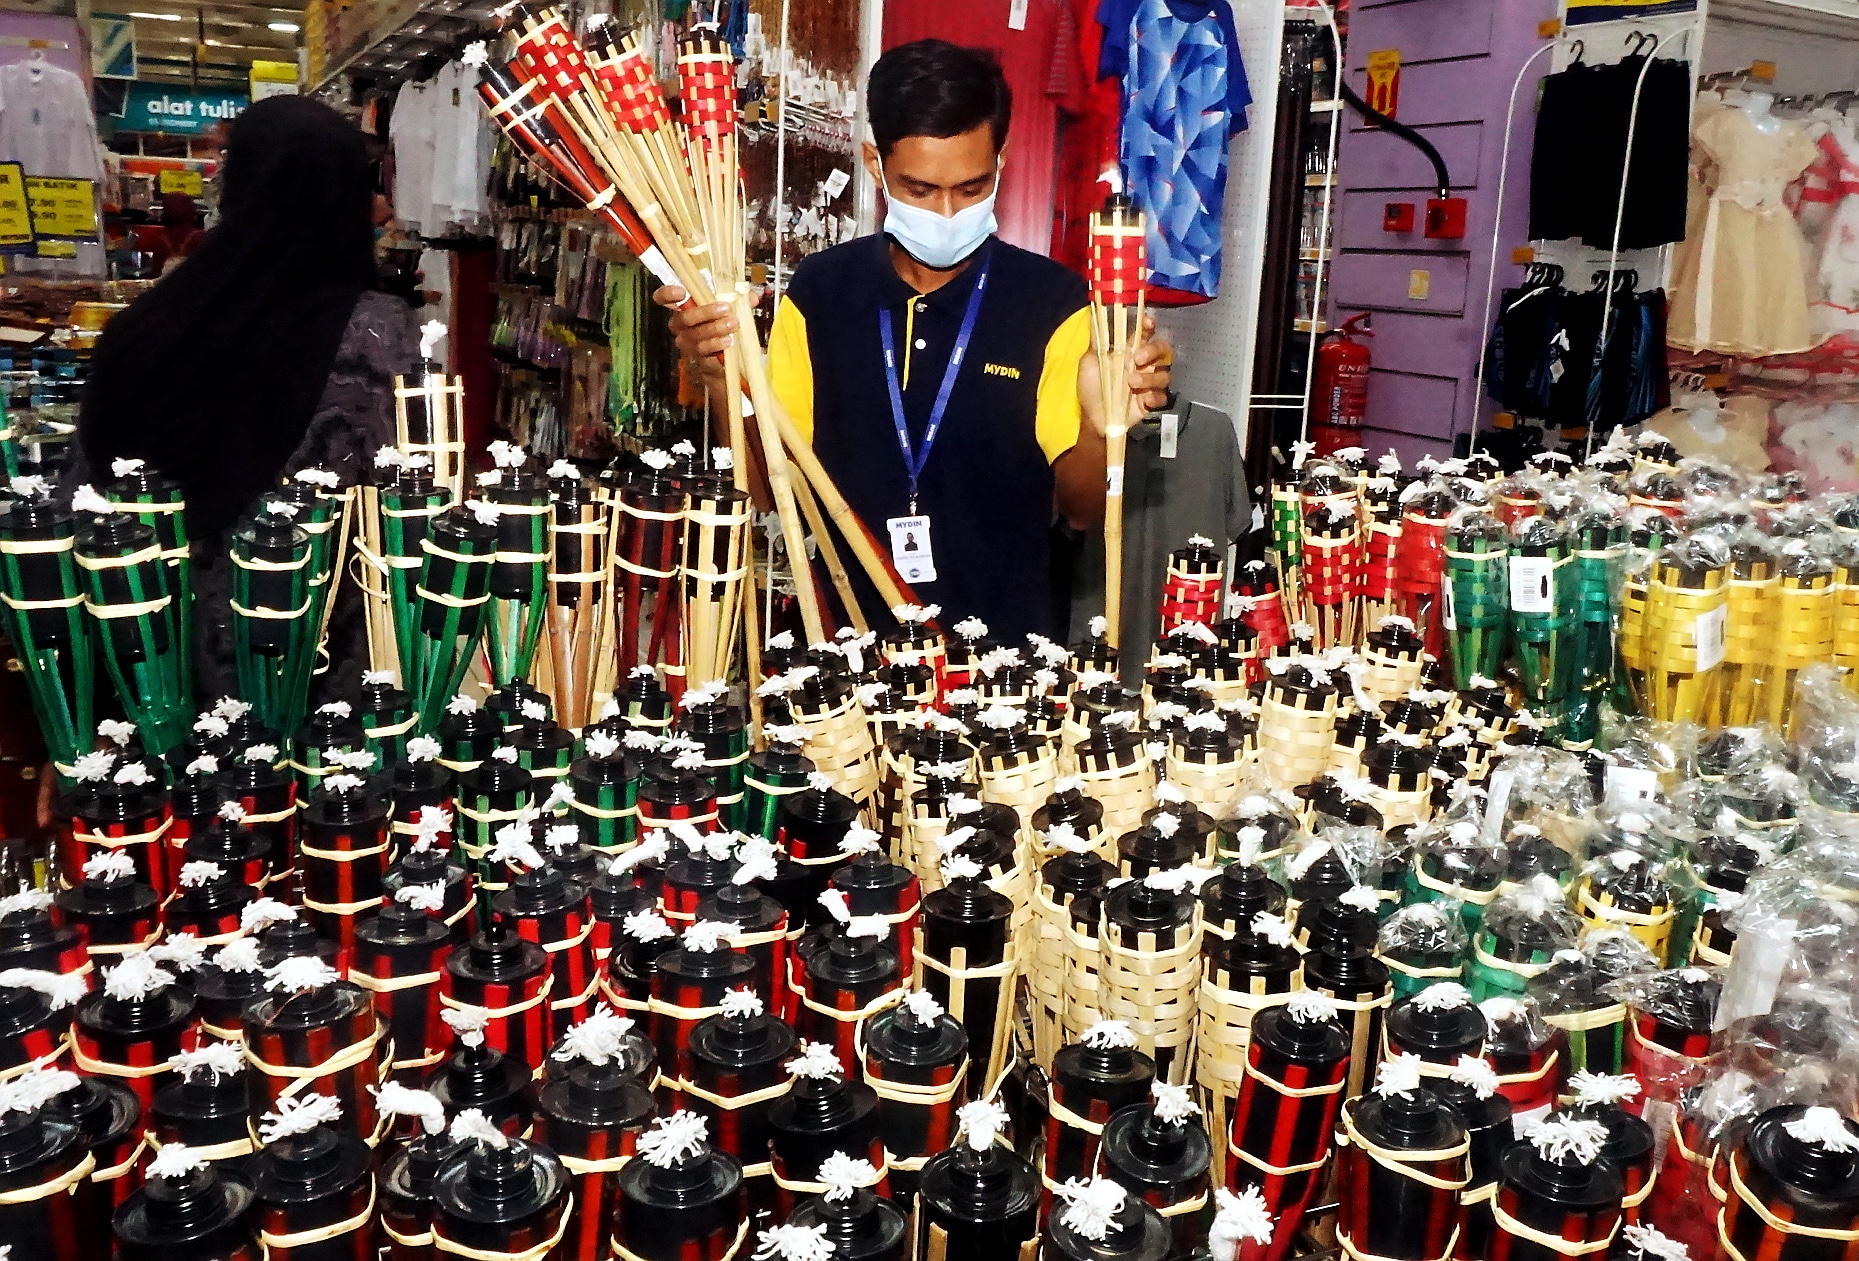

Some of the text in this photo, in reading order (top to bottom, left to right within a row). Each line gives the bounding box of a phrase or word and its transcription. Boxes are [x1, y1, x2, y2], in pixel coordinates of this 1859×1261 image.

[147, 95, 193, 116] alat
[984, 363, 1020, 380] MYDIN
[895, 520, 922, 529] MYDIN
